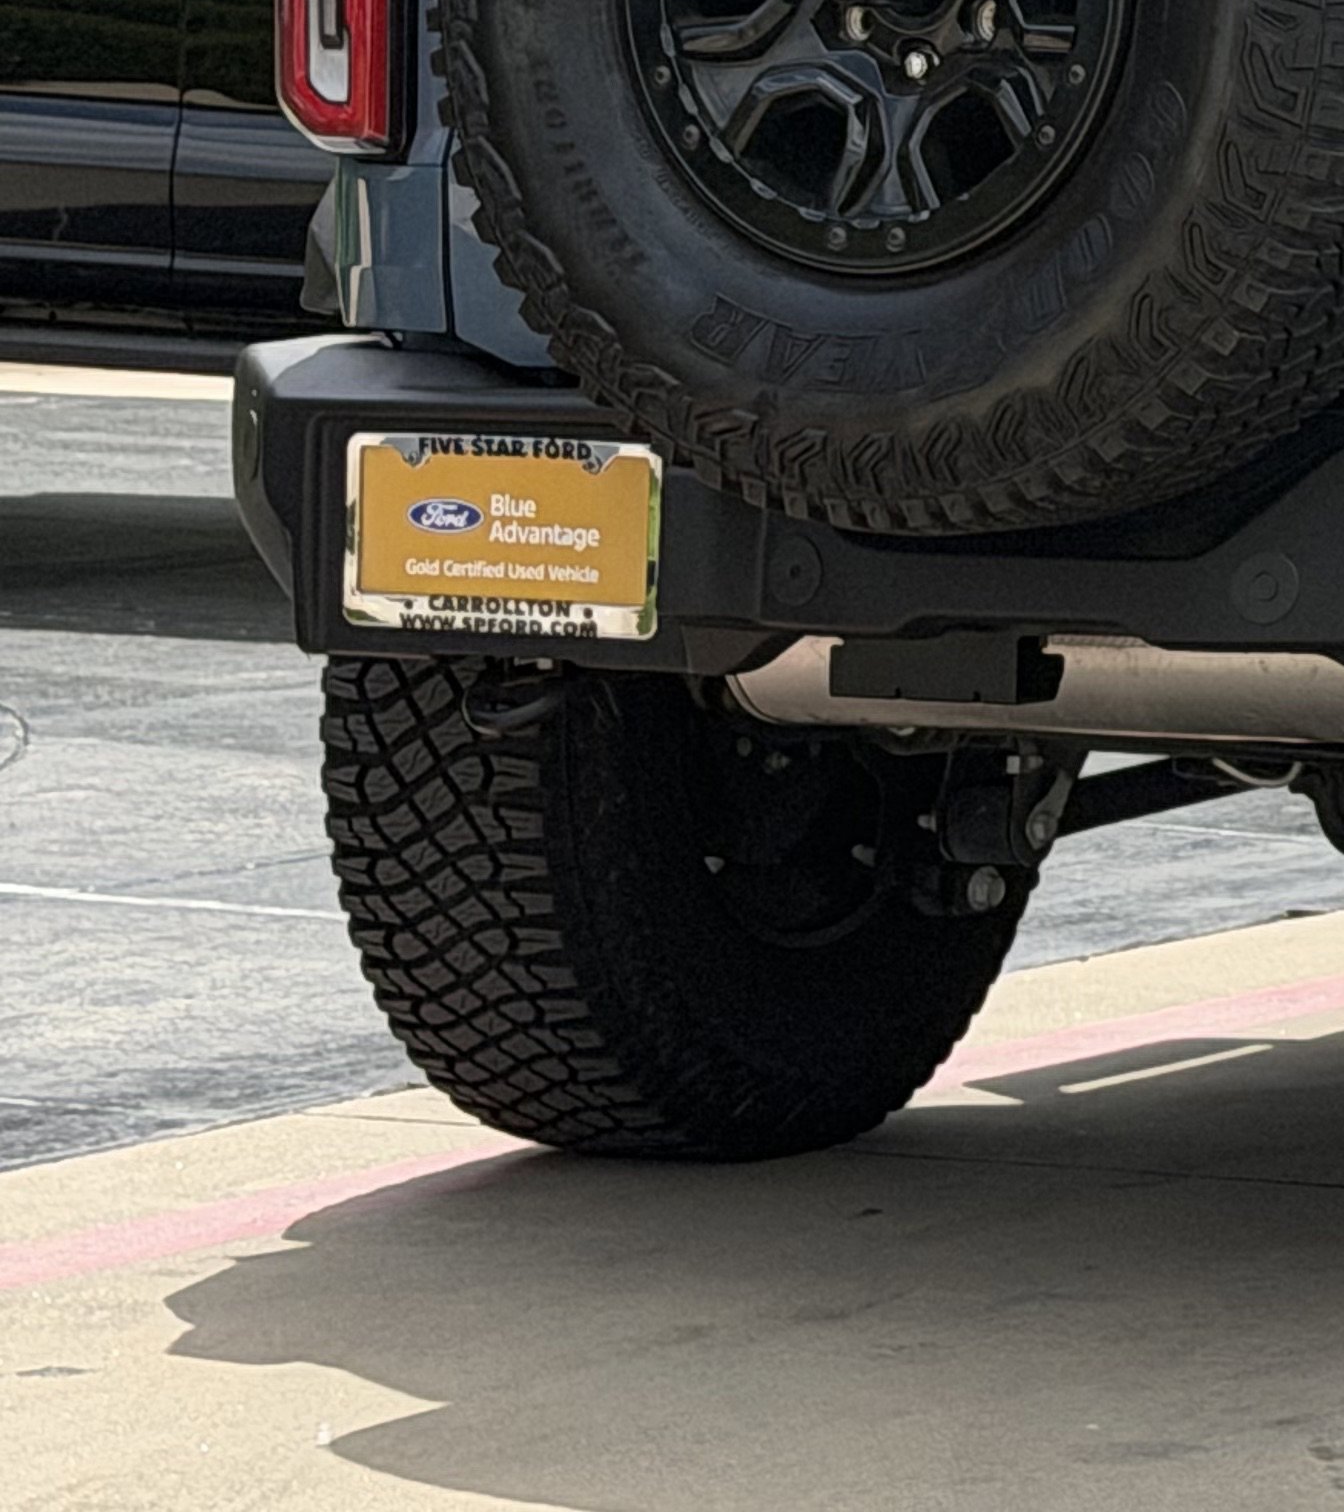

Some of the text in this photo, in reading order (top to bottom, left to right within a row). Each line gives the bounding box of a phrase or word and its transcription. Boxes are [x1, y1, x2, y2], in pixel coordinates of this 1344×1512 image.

[419, 437, 592, 461] FIVE STAR FORD
[420, 501, 470, 528] Ford
[490, 494, 537, 519] Blue
[489, 520, 601, 551] Advantage
[405, 558, 599, 584] Gold Certified Used Vehicle
[428, 593, 572, 618] CARROLLTON
